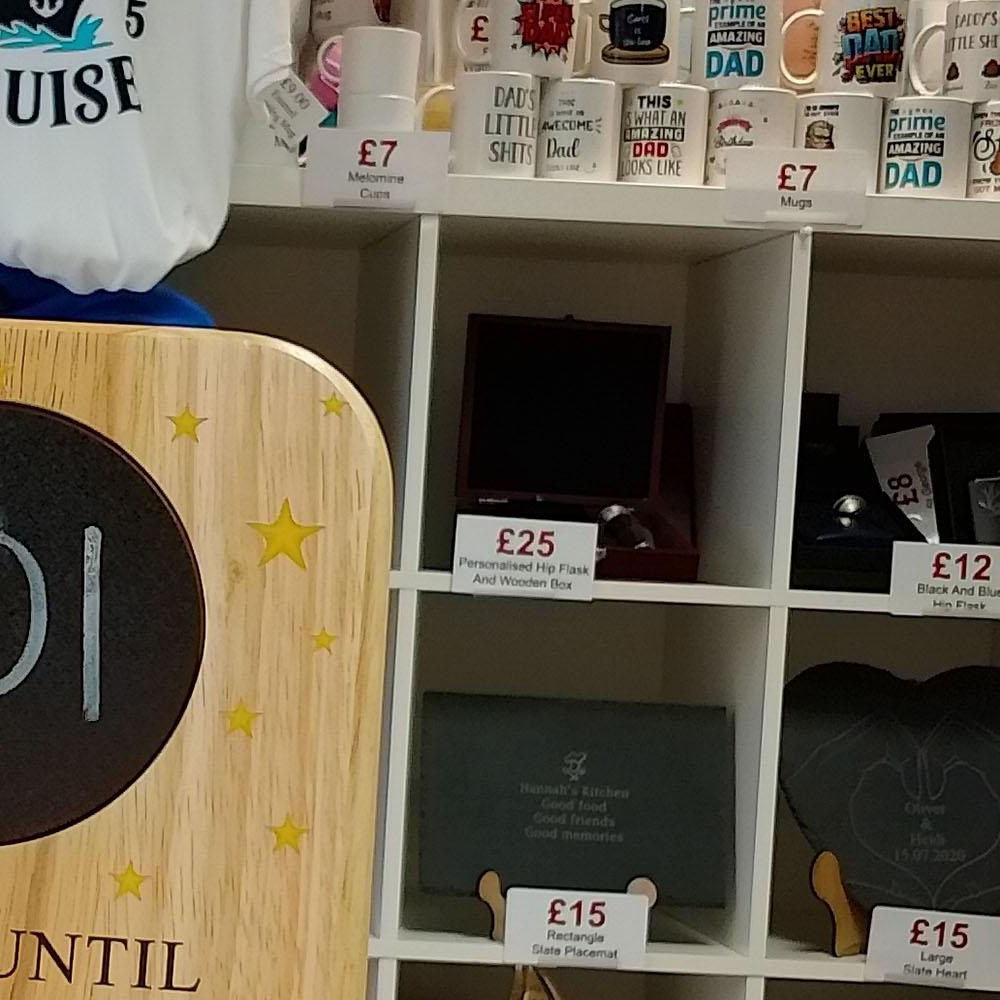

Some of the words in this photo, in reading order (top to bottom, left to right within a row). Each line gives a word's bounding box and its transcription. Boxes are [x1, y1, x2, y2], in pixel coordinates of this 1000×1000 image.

[124, 0, 147, 39] 5
[708, 5, 766, 27] prime
[846, 8, 896, 32] BEST
[710, 31, 763, 43] AMAZING
[842, 29, 899, 57] DAD
[706, 50, 764, 78] DAD
[855, 63, 894, 79] EVER
[494, 86, 536, 111] DAD'S
[637, 95, 672, 109] THIS
[634, 110, 667, 126] WHAT
[670, 111, 686, 126] AN
[888, 116, 946, 138] prime
[625, 128, 683, 141] AMAZING
[358, 139, 398, 167] £7
[488, 141, 533, 165] SHITS
[632, 142, 669, 157] DAD
[889, 142, 941, 154] AMAZING
[621, 159, 652, 176] LOOKS
[657, 160, 682, 176] LIKE
[778, 163, 817, 191] £7
[885, 161, 942, 189] DAD
[780, 195, 812, 210] Mugs
[496, 528, 555, 557] £25
[459, 557, 532, 572] Personalised
[536, 562, 556, 575] Hip
[559, 563, 589, 576] Flask
[932, 552, 992, 581] £12
[472, 573, 496, 586] And
[500, 575, 547, 588] Wooden
[550, 578, 573, 590] Box
[917, 583, 948, 595] Black
[951, 585, 974, 597] And
[548, 899, 606, 927] £15
[547, 929, 605, 945] Rectangle
[910, 918, 969, 949] £15
[532, 944, 561, 956] Slate
[564, 945, 618, 959] Placemat
[920, 951, 954, 965] Large
[936, 967, 968, 980] Heart
